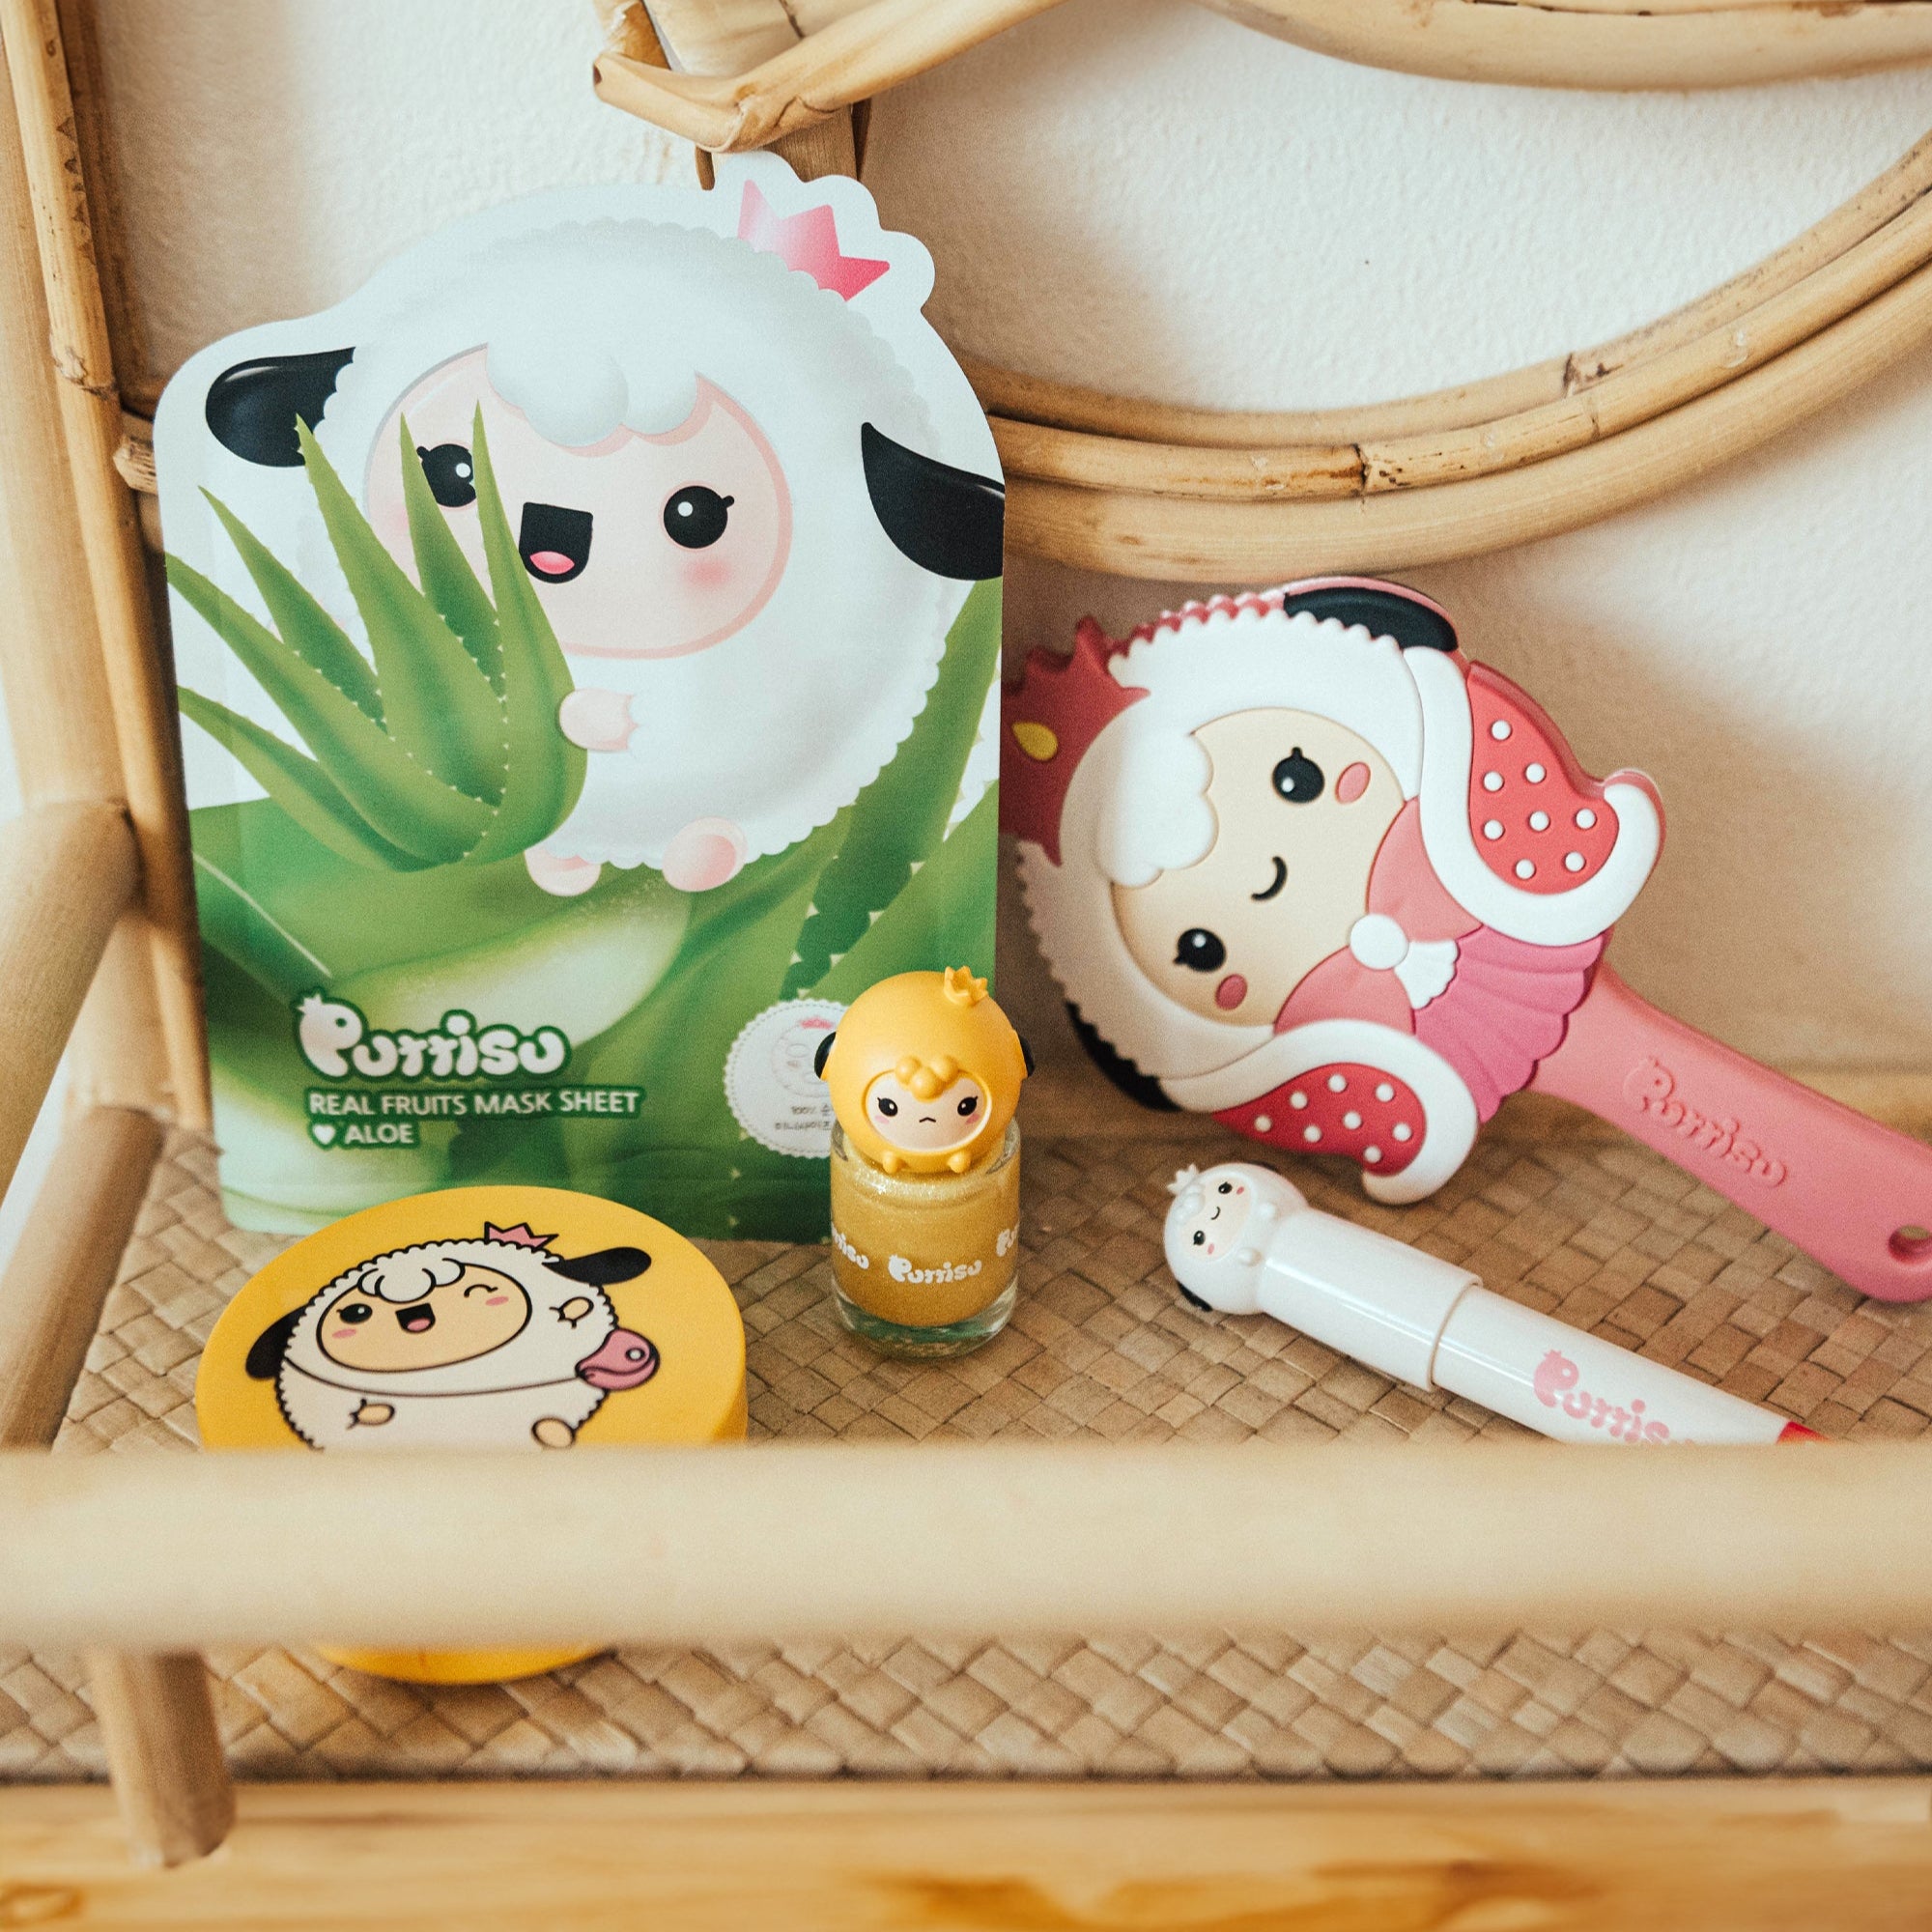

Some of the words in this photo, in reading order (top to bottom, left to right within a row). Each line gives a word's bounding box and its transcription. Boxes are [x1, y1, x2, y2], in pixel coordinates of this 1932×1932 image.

[309, 1092, 375, 1116] REAL
[382, 1094, 467, 1116] FRUITS
[474, 1092, 552, 1115] MASK
[560, 1090, 639, 1114] SHEET
[344, 1122, 414, 1145] ALOE
